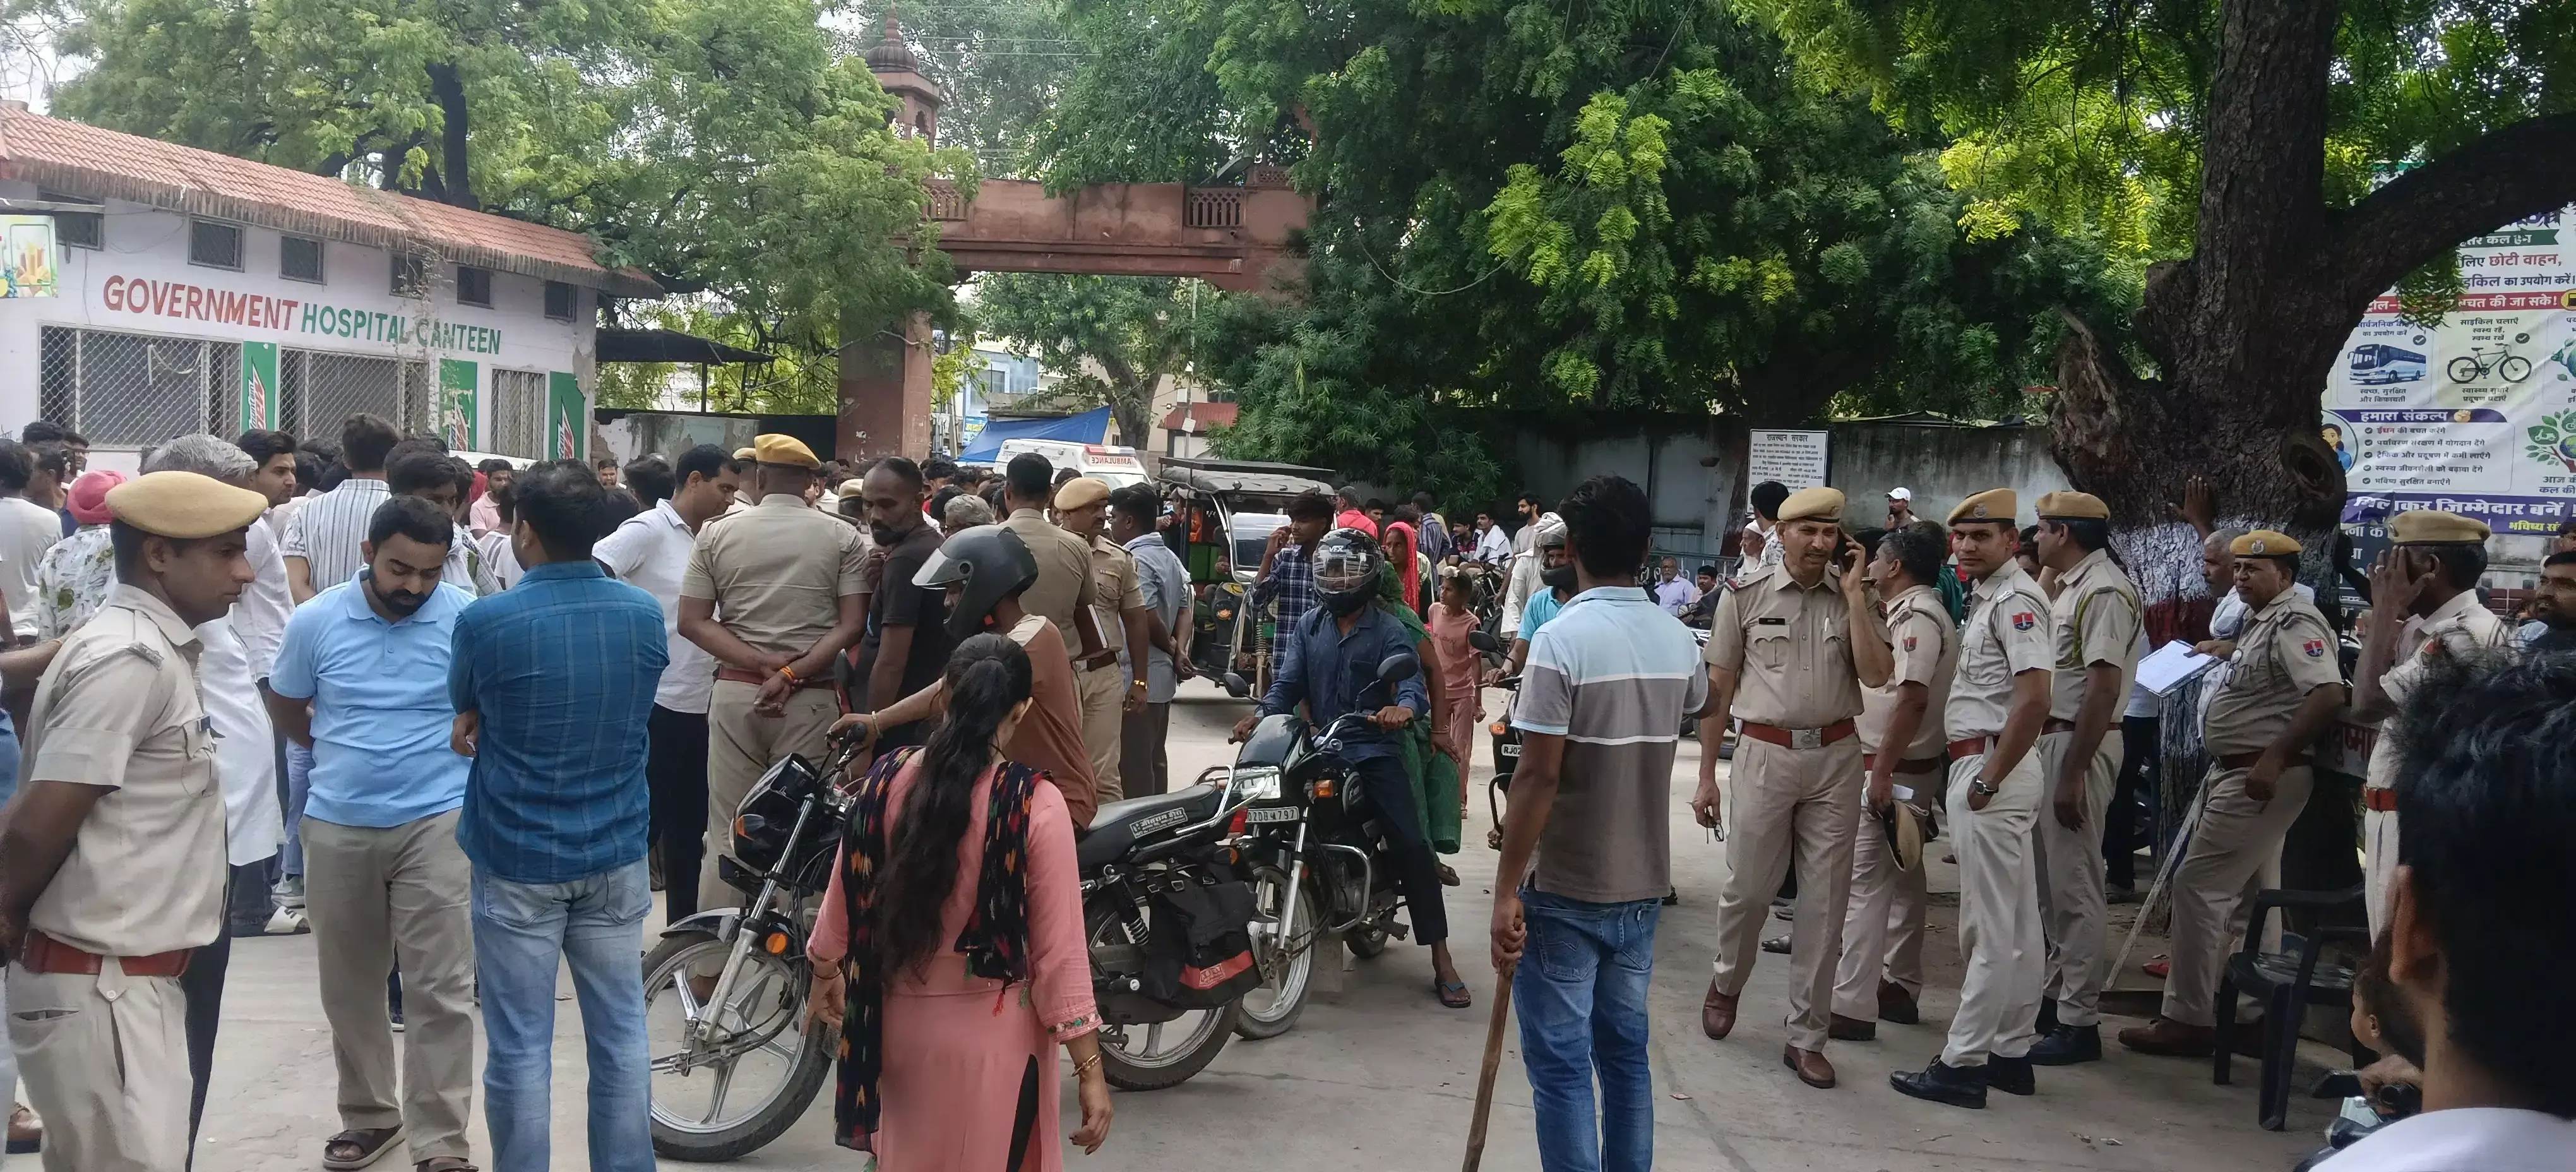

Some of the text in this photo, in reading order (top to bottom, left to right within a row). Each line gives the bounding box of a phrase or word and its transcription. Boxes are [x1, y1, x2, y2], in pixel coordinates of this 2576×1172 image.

[2486, 235, 2511, 244] कल
[2489, 251, 2520, 266] छोटी
[2523, 253, 2563, 266] वाहन,
[2504, 277, 2519, 286] का
[2520, 273, 2552, 285] उपयोग
[2490, 294, 2507, 308] की
[2510, 297, 2526, 307] जा
[103, 275, 502, 355] GOVERNMENT HOSPITAL CANTEEN
[2460, 317, 2493, 326] साइकिल
[2360, 409, 2448, 422] हमारा संकल्प
[2435, 464, 2445, 472] को
[2435, 498, 2526, 515] जिम्मेदार
